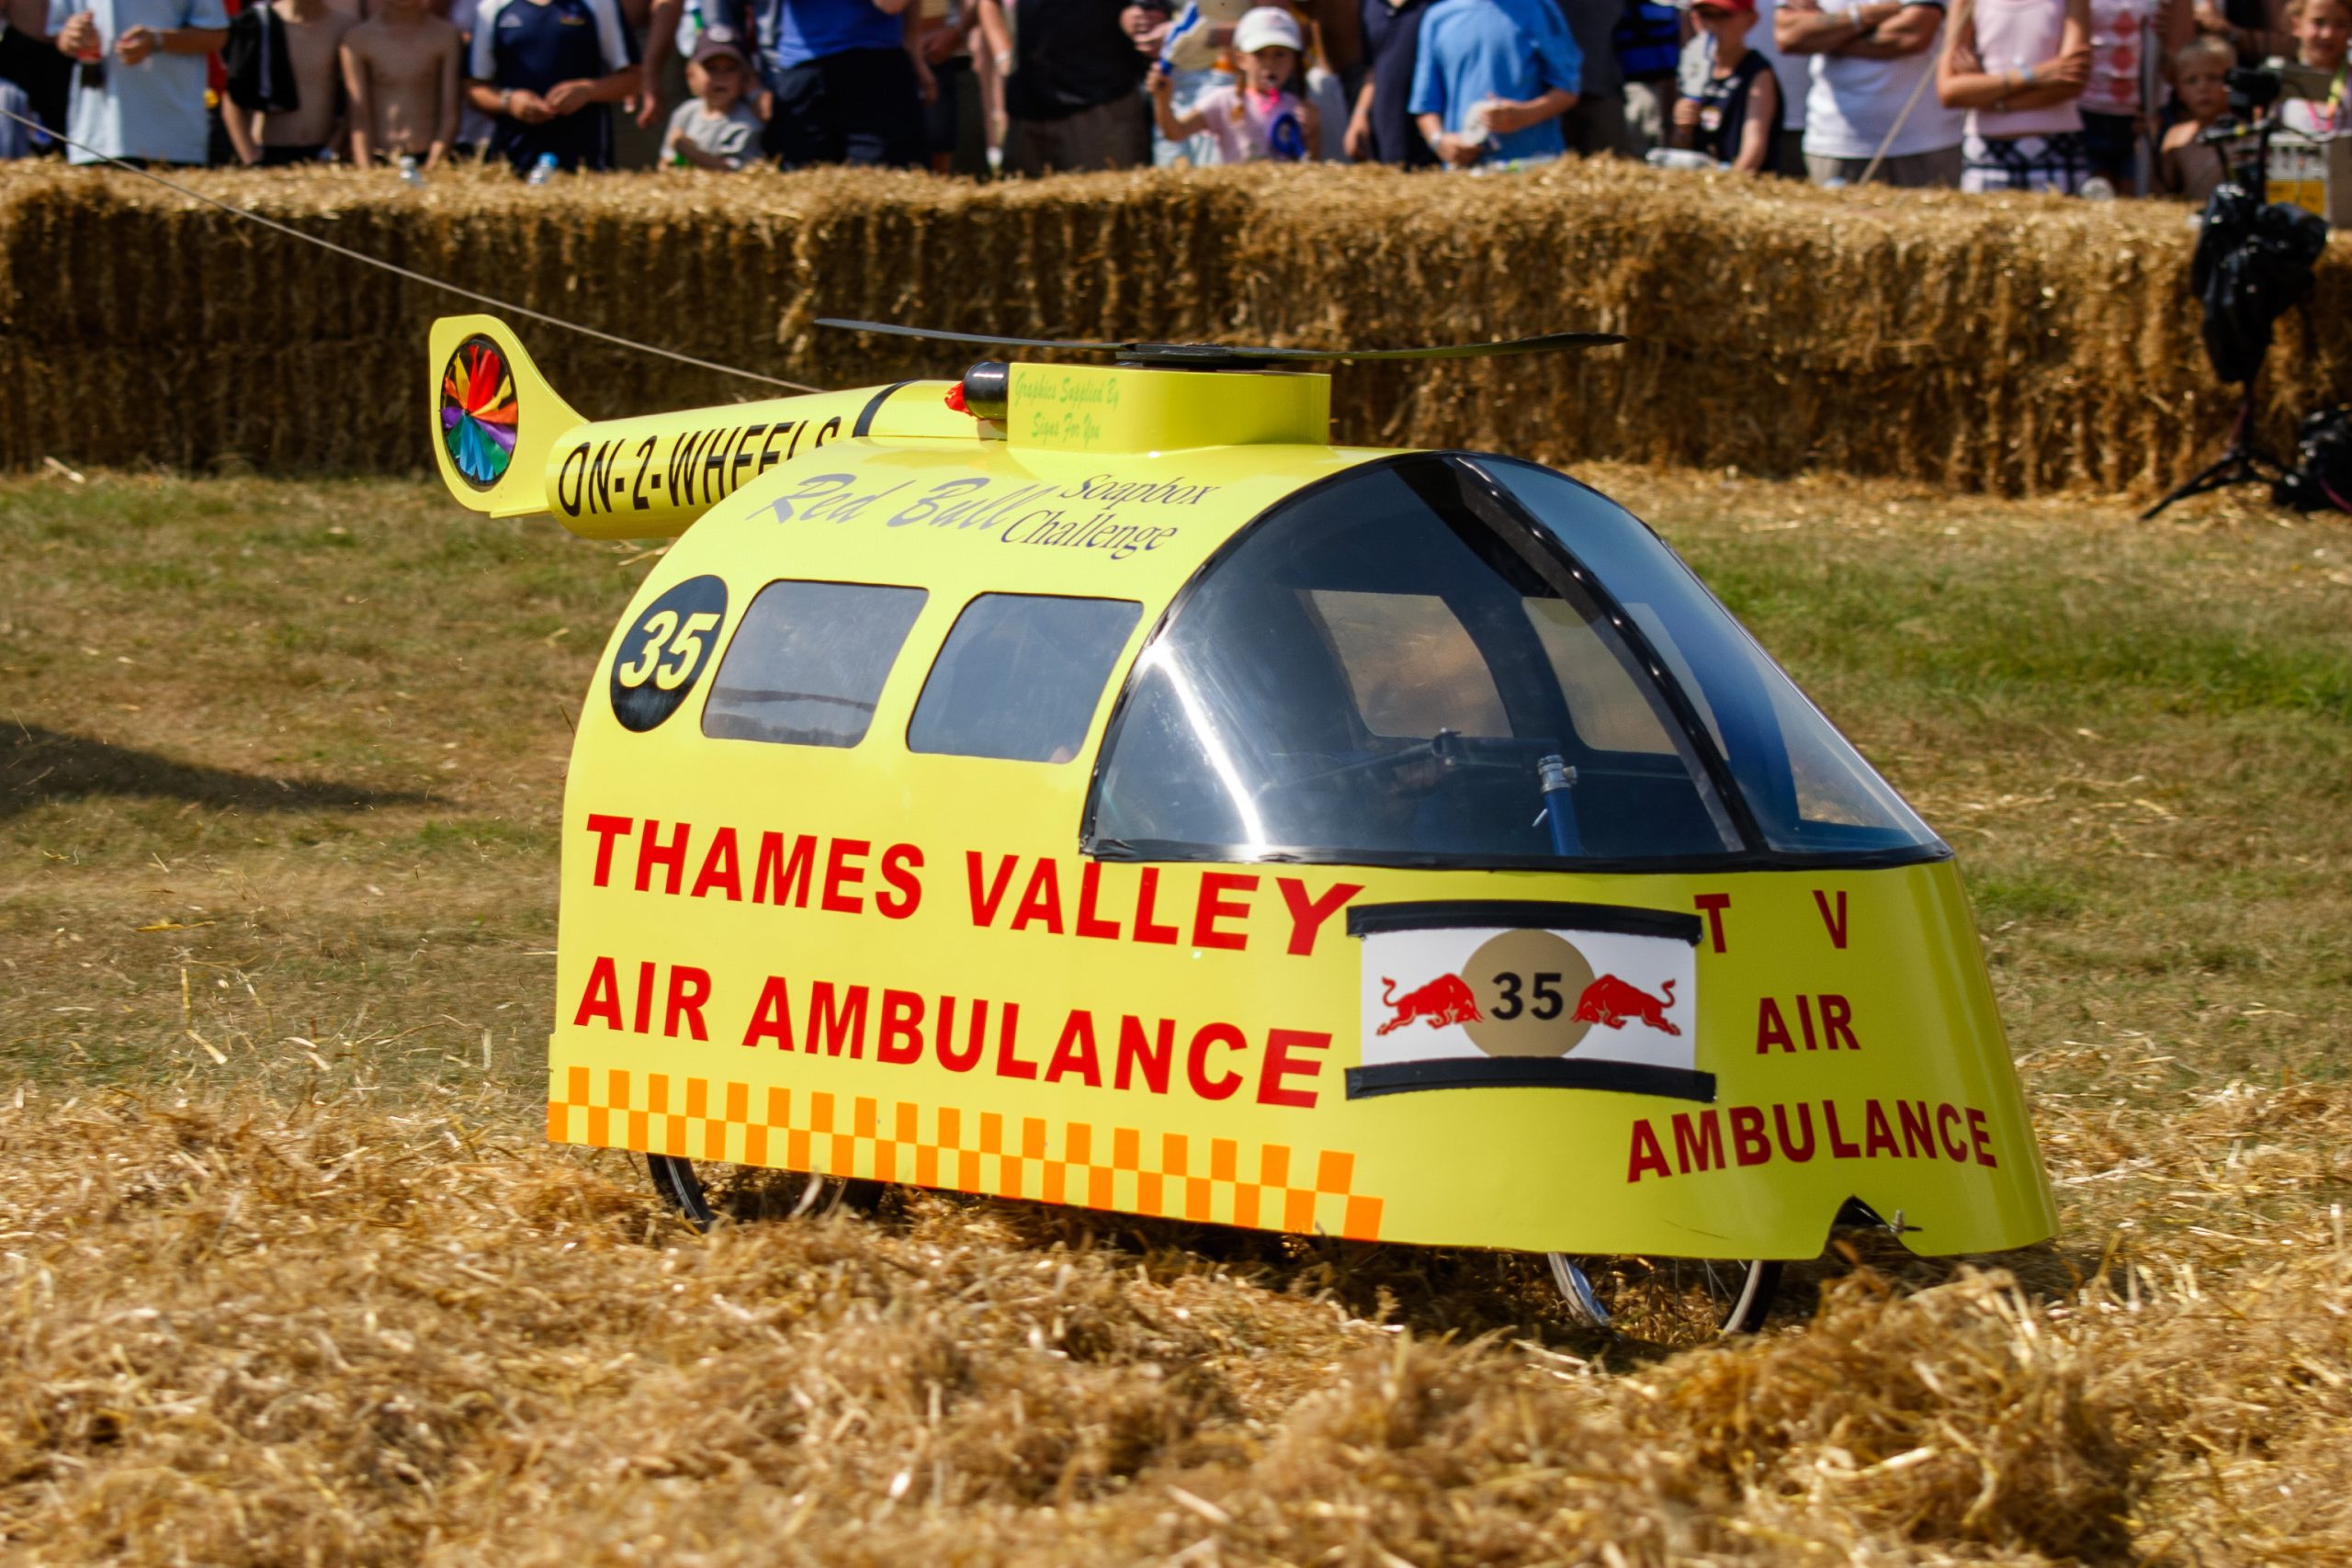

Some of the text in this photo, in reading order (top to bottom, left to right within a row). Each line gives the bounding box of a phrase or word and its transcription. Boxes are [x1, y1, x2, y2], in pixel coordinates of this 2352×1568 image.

[1014, 371, 1057, 406] Graphics
[1060, 377, 1103, 408] Supplied
[1032, 412, 1058, 445] Signs
[745, 473, 1061, 530] Red Bull
[1058, 473, 1222, 510] Soapbox
[1000, 509, 1179, 560] Challenge
[619, 610, 721, 691] 35
[586, 813, 1364, 956] THAMES VALLEY
[1694, 890, 1847, 953] T V
[1490, 971, 1564, 1021] 35
[1756, 994, 1861, 1055] AIR
[573, 956, 1332, 1109] AIR AMBULANCE
[1627, 1100, 1997, 1184] AMBULANCE
